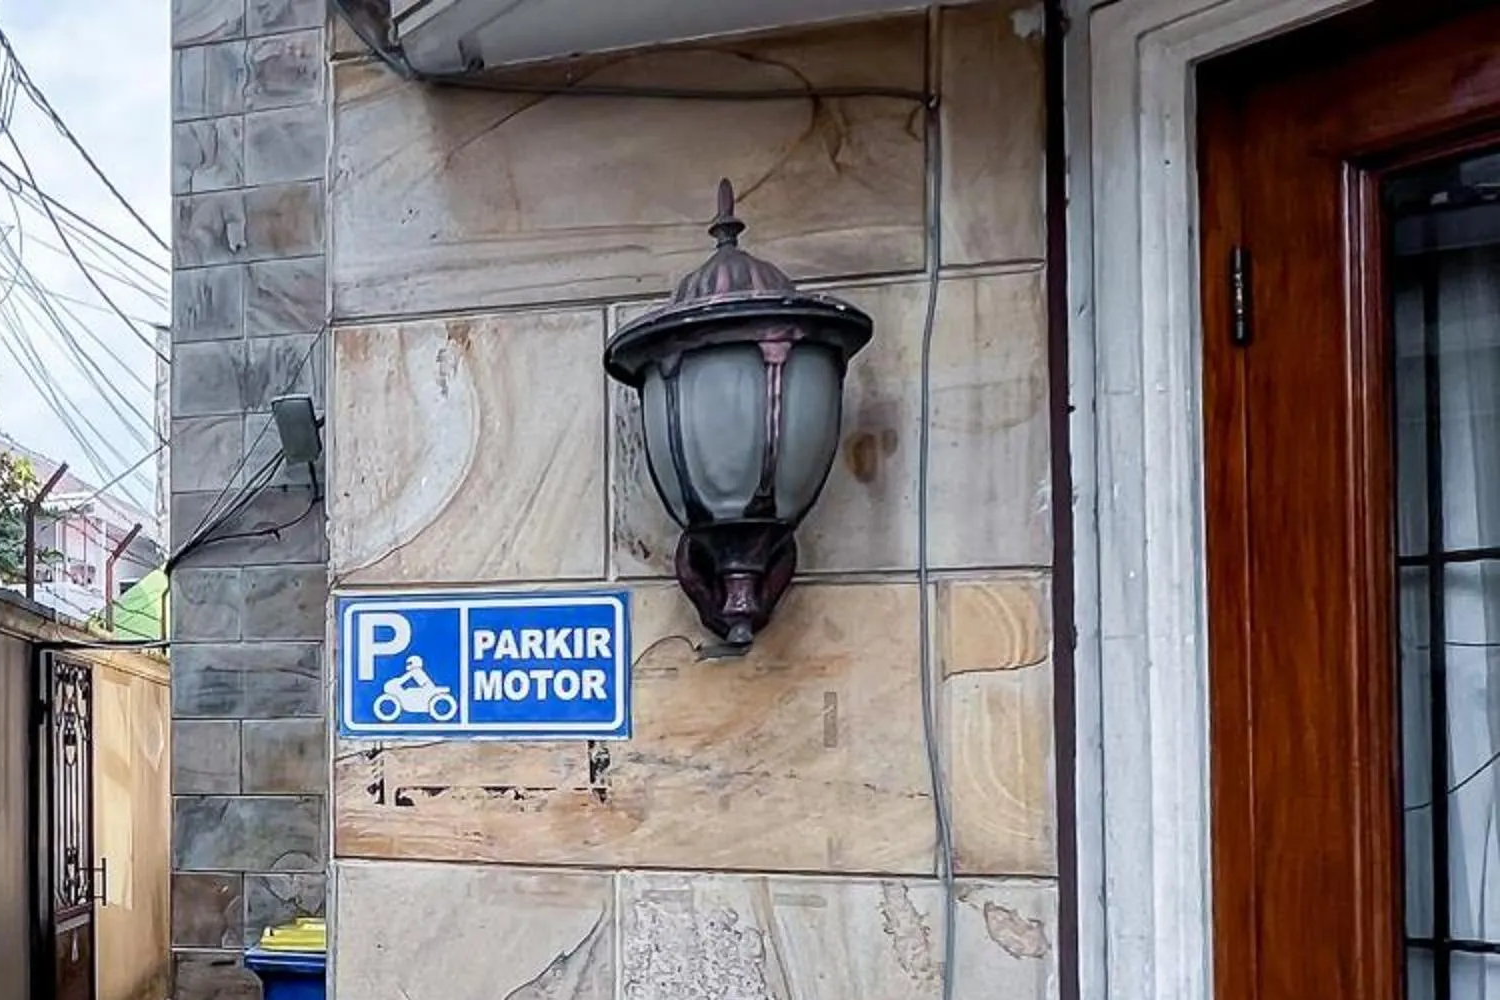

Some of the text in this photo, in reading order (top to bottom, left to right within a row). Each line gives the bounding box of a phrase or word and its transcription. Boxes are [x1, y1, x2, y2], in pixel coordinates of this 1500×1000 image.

[357, 612, 412, 681] P
[473, 627, 612, 660] PARKIR
[473, 669, 607, 701] MOTOR
